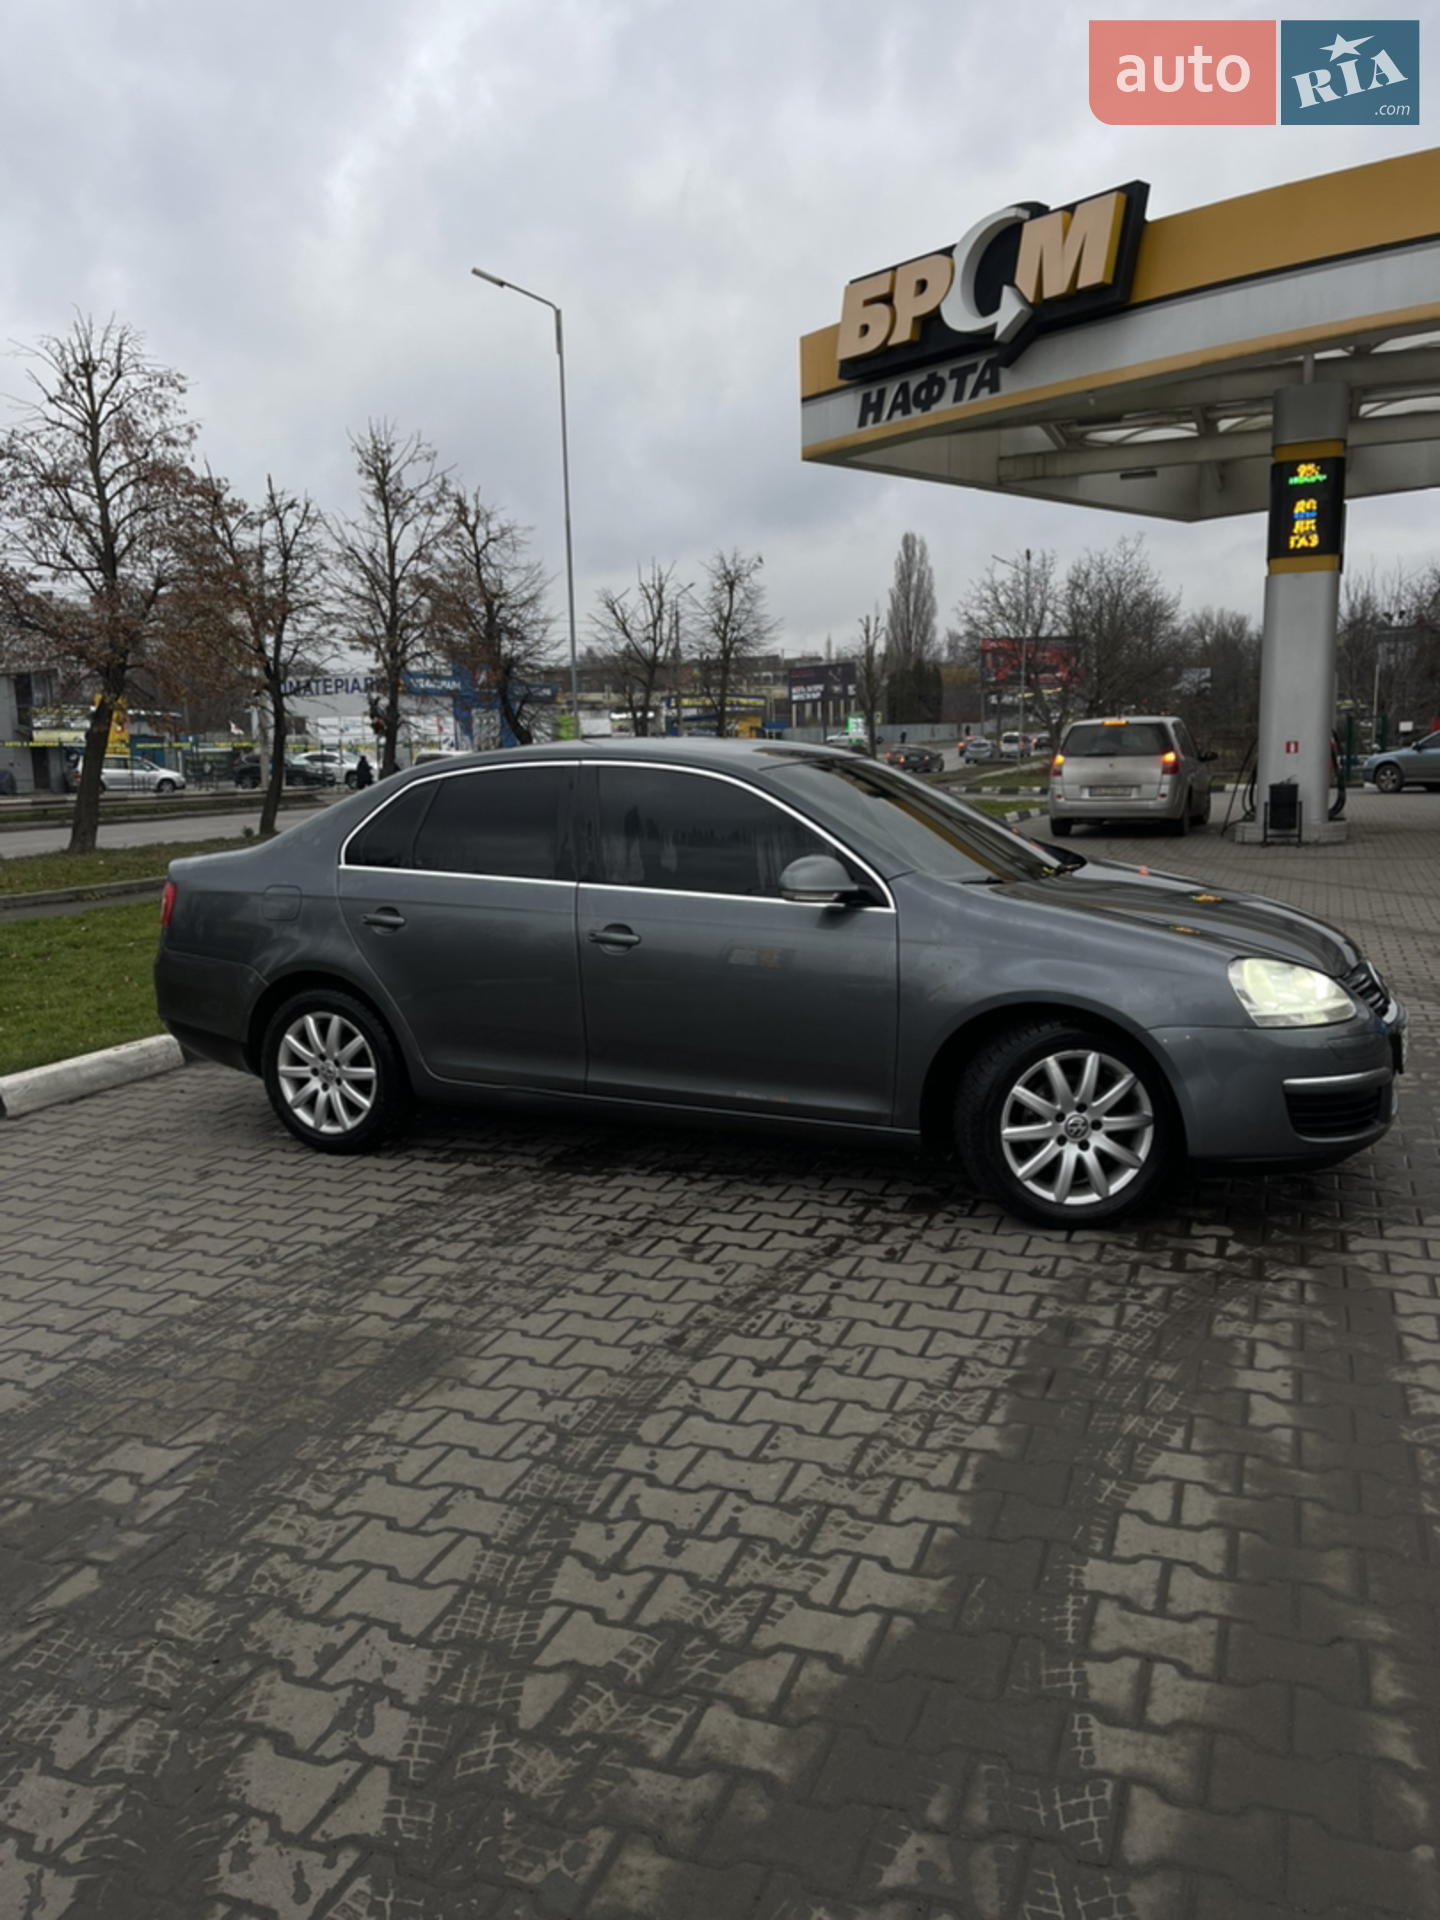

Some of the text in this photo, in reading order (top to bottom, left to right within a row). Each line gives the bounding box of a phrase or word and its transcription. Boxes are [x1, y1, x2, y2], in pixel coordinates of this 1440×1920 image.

[837, 191, 1127, 361] БРСМ
[856, 354, 1001, 429] НАФТА
[1288, 533, 1320, 549] ГАЗ
